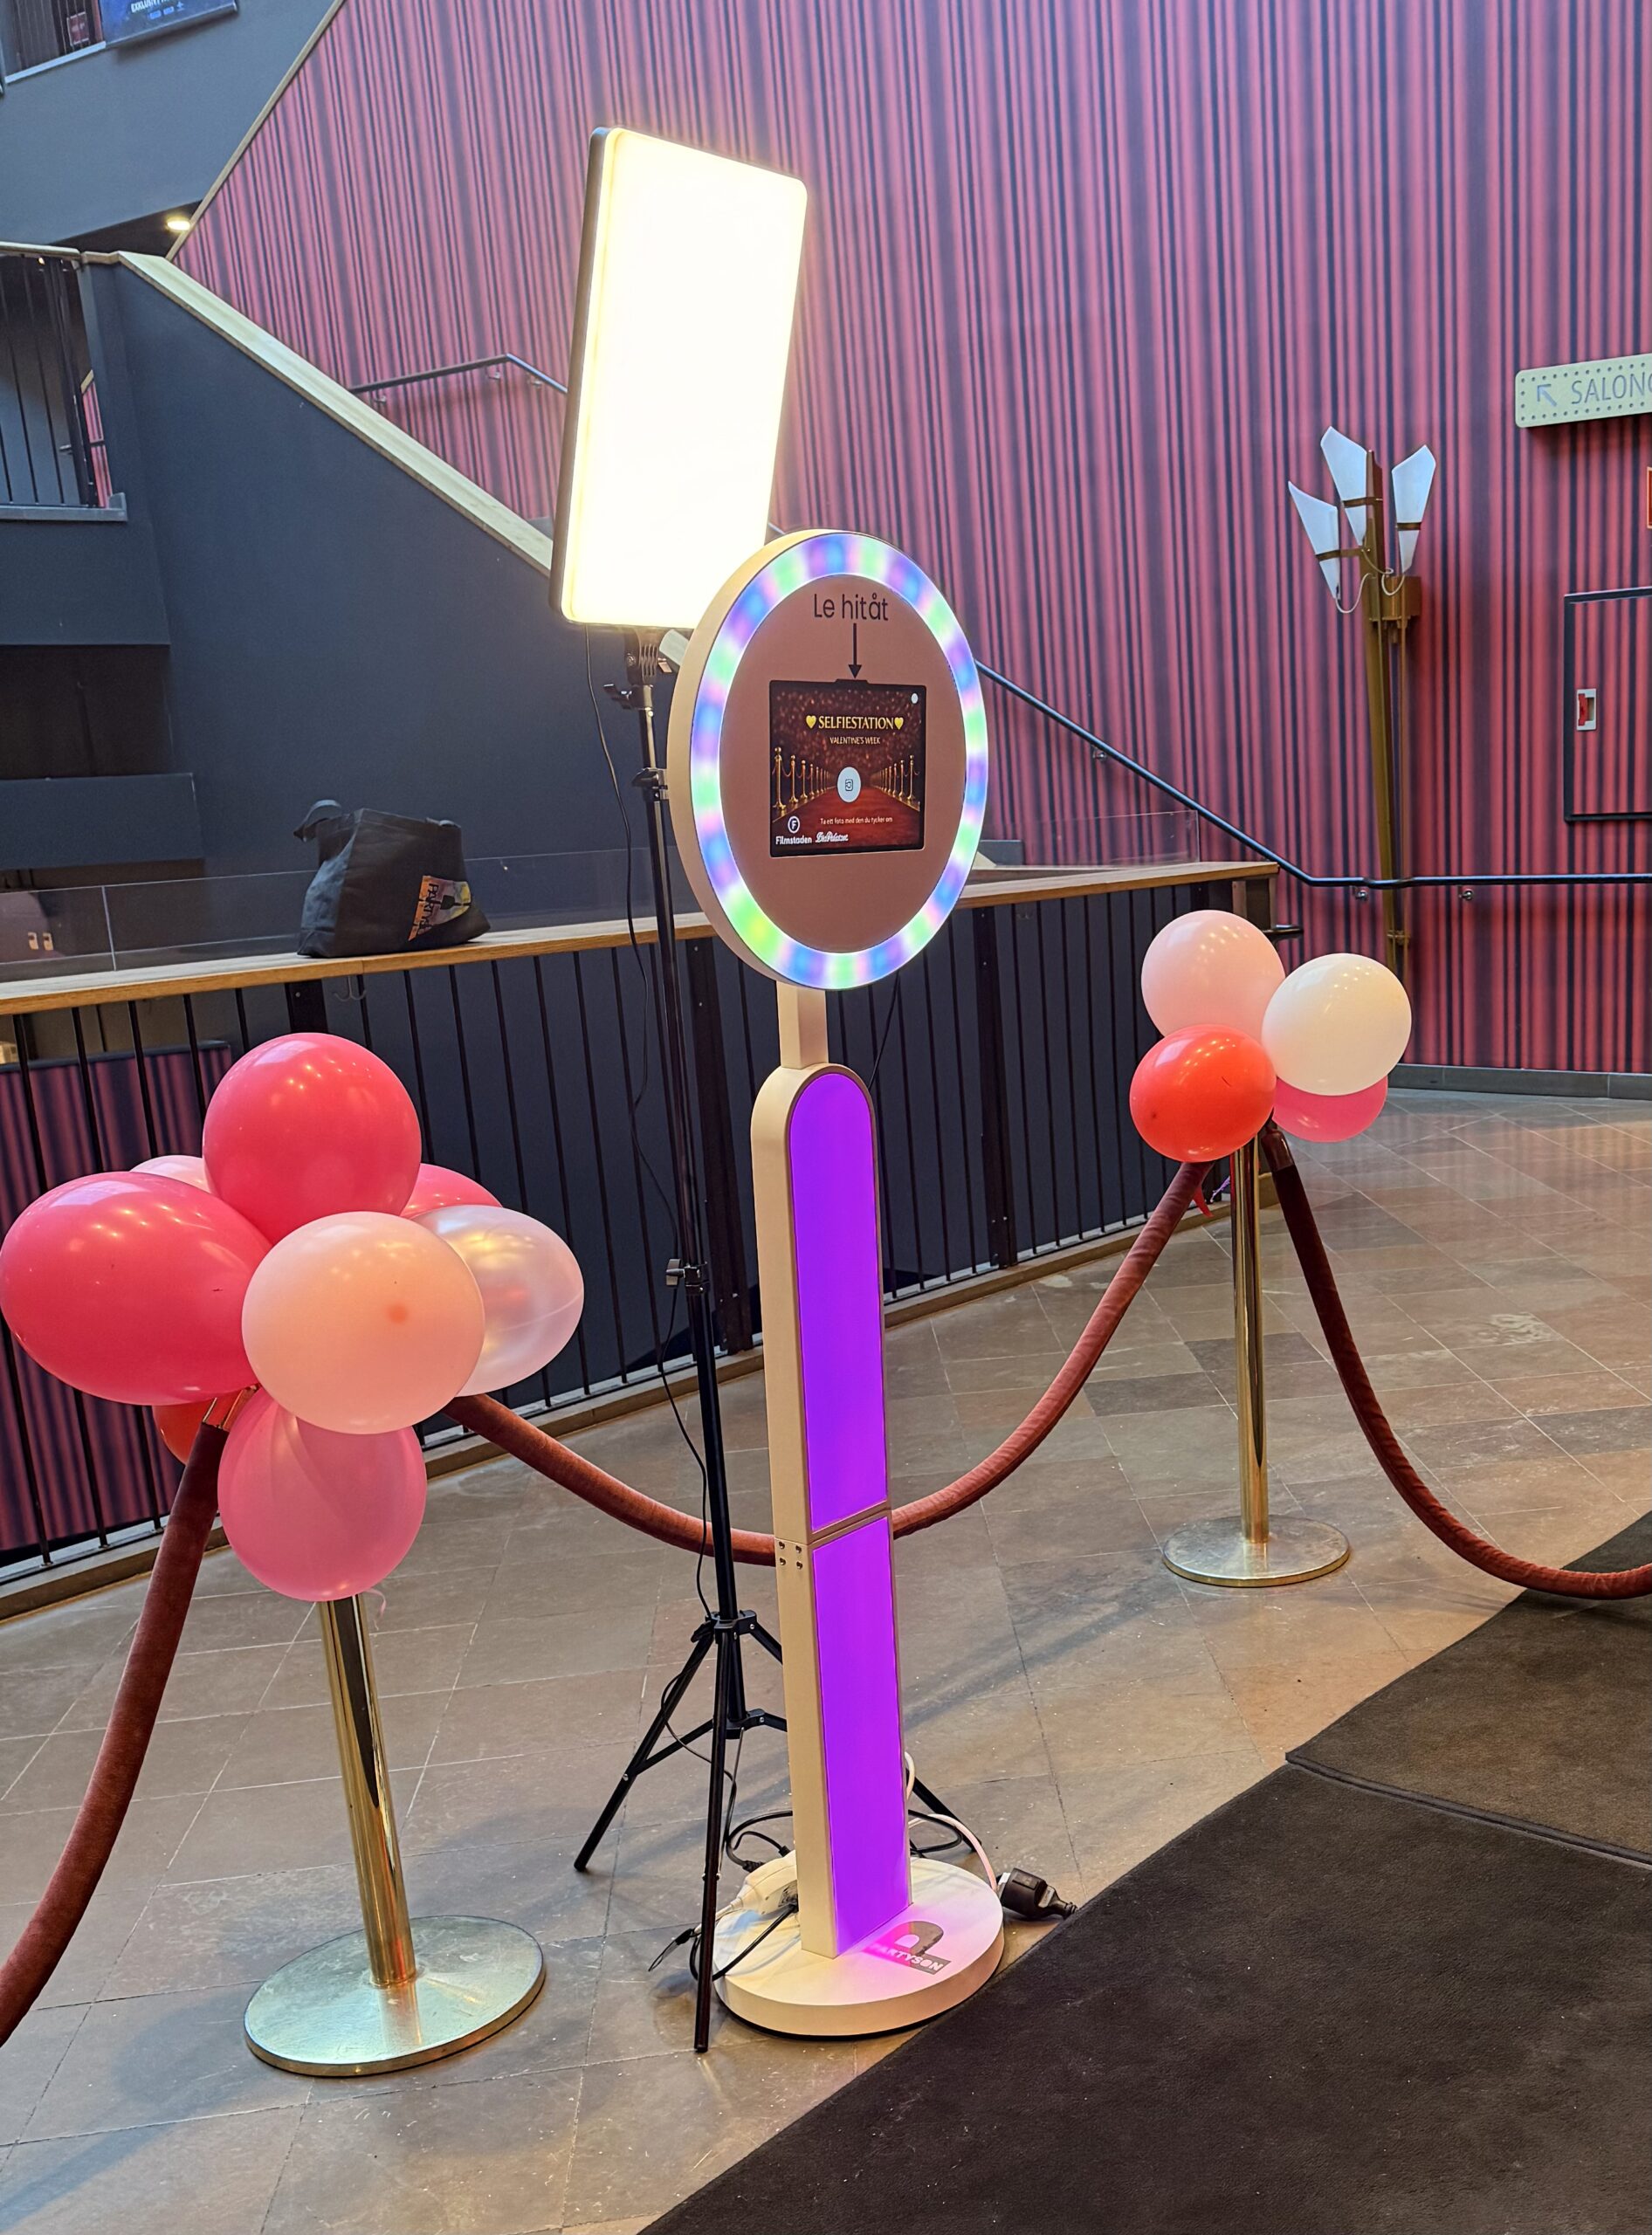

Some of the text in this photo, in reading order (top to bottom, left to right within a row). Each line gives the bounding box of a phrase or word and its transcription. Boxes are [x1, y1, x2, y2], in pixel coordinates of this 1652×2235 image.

[814, 592, 889, 621] Le hitåt
[818, 715, 894, 730] SELFIESTATION
[829, 736, 864, 745] VALENTINE'S
[871, 815, 885, 825] tycker
[775, 835, 813, 845] Filmstaden
